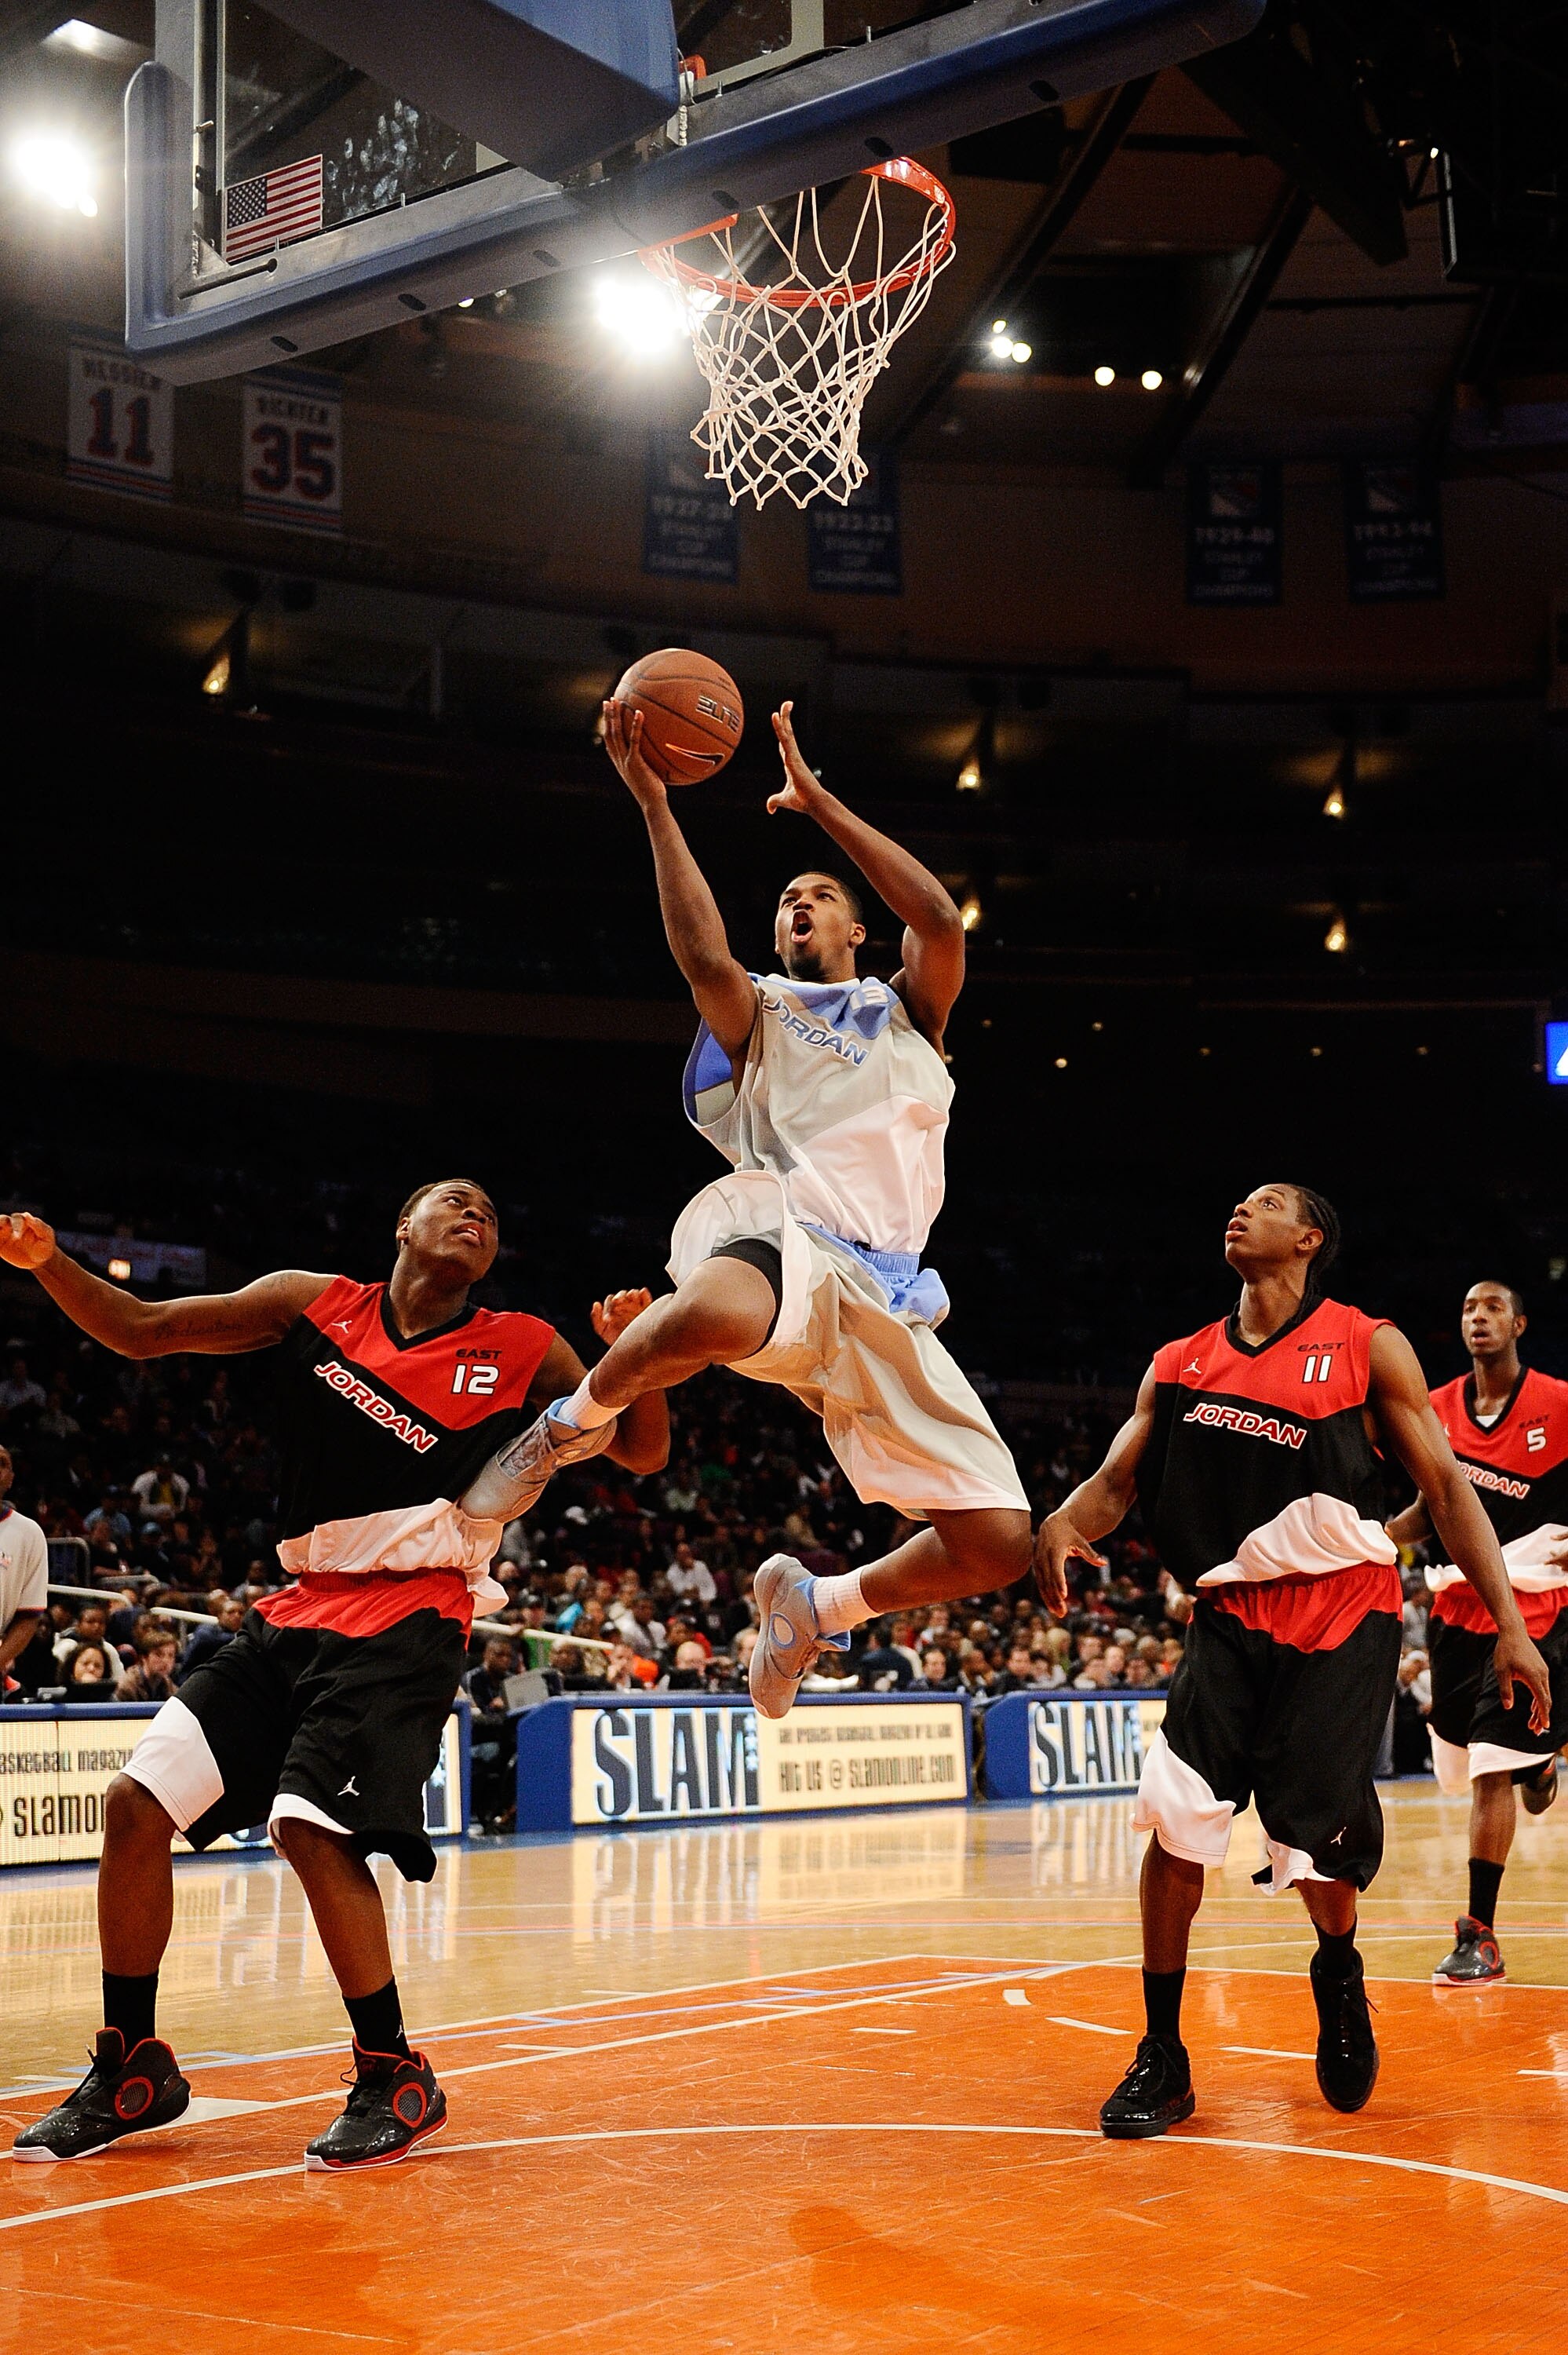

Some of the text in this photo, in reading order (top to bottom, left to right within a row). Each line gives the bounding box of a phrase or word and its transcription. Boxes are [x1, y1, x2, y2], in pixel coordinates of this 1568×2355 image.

[87, 387, 155, 466] 11
[251, 422, 335, 500] 35
[695, 695, 740, 734] ELITE
[762, 995, 869, 1068] JORDAN
[455, 1348, 502, 1360] EAST
[1297, 1342, 1344, 1352] EAST
[450, 1363, 500, 1397] 12
[1301, 1354, 1333, 1384] 11
[313, 1360, 439, 1454] JORDAN
[1183, 1402, 1307, 1449] JORDAN
[1526, 1426, 1547, 1453] 5
[1457, 1460, 1530, 1500] ORDAN
[593, 1708, 760, 1816] SLAM
[1034, 1701, 1143, 1788] SLAM
